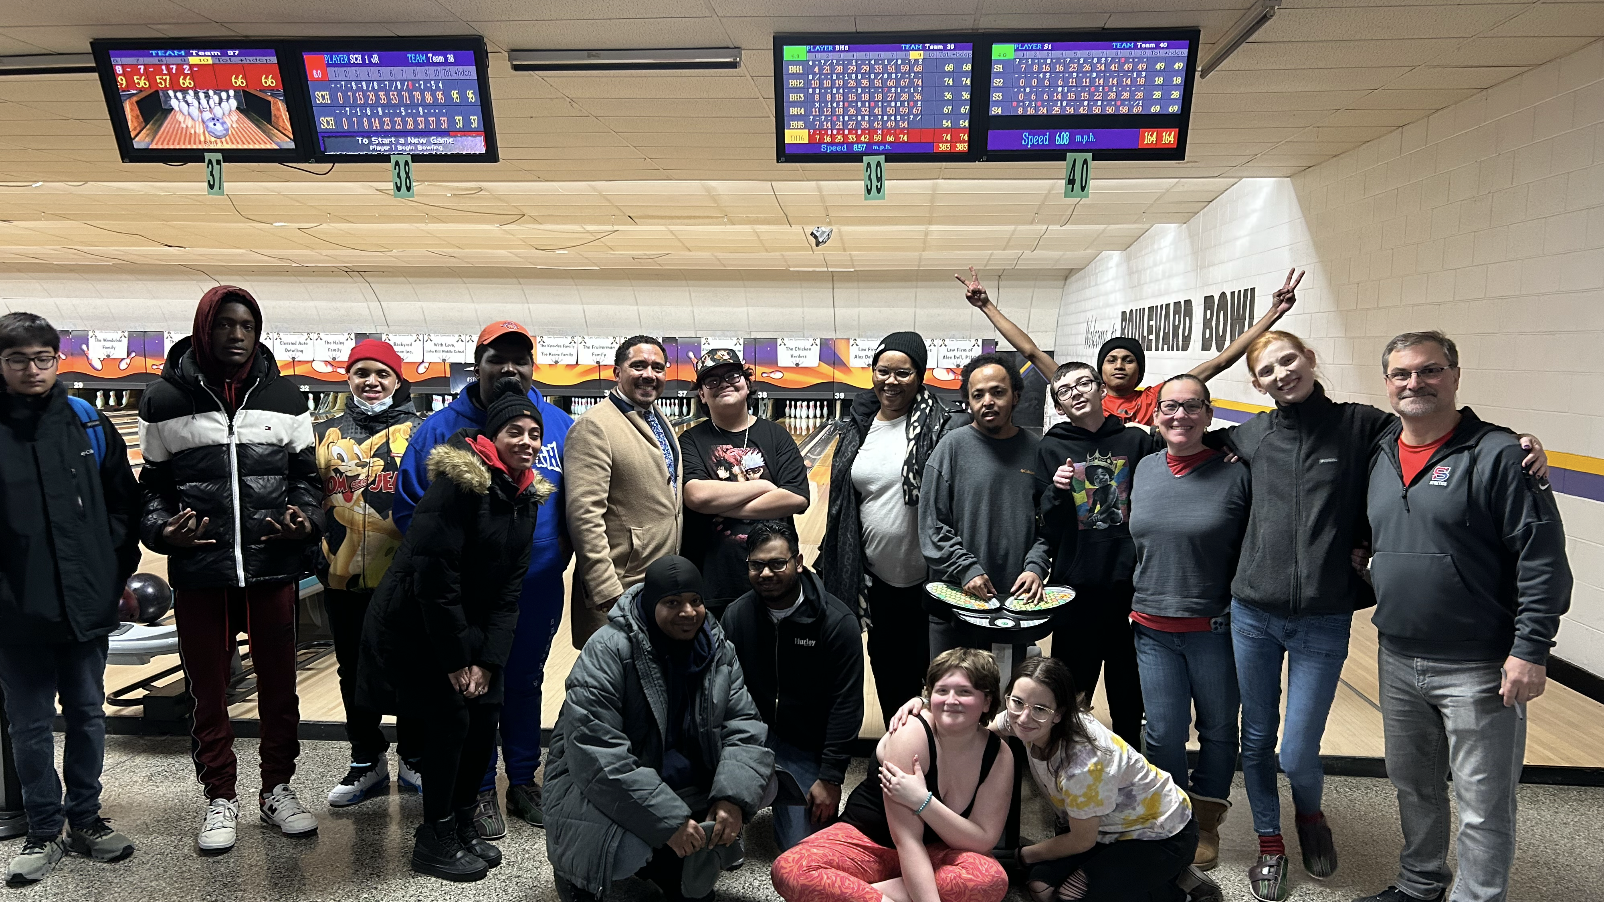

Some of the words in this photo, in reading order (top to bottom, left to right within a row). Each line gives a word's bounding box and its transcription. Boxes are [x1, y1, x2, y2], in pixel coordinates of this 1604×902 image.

[324, 54, 348, 64] PLAYER
[349, 54, 362, 64] SCH
[364, 54, 369, 64] 1
[406, 53, 427, 63] TEAM
[428, 53, 445, 63] Team
[446, 53, 455, 63] 38
[115, 65, 122, 74] 8
[137, 65, 144, 74] 7
[161, 65, 168, 74] 1
[170, 65, 177, 74] 7
[183, 65, 191, 74] 2
[788, 65, 803, 74] BH1
[944, 63, 954, 71] 68
[962, 63, 972, 71] 68
[993, 64, 1003, 72] S1
[1155, 62, 1165, 70] 49
[1173, 62, 1183, 70] 49
[133, 76, 149, 88] 56
[155, 76, 170, 88] 57
[179, 76, 194, 88] 66
[231, 74, 246, 87] 66
[261, 74, 276, 87] 66
[788, 79, 804, 88] BH2
[943, 77, 953, 86] 74
[961, 77, 971, 86] 74
[993, 78, 1003, 86] S2
[1154, 76, 1163, 85] 18
[1172, 76, 1181, 85] 18
[315, 92, 331, 104] SCH
[337, 92, 343, 104] 0
[348, 92, 353, 104] 7
[355, 92, 364, 104] 13
[367, 92, 376, 104] 29
[389, 92, 399, 104] 53
[401, 92, 410, 104] 71
[413, 92, 421, 104] 79
[424, 92, 433, 104] 86
[436, 92, 445, 104] 95
[451, 90, 460, 103] 95
[466, 90, 475, 103] 95
[789, 93, 804, 101] BH3
[943, 91, 953, 100] 36
[961, 91, 970, 100] 36
[992, 92, 1003, 100] S3
[1152, 91, 1162, 99] 28
[1170, 91, 1180, 99] 28
[789, 107, 805, 115] BH4
[943, 105, 953, 114] 67
[960, 105, 970, 114] 67
[991, 106, 1002, 114] S4
[1150, 105, 1160, 113] 69
[1168, 105, 1178, 113] 69
[320, 117, 335, 129] SCH
[342, 117, 348, 129] 0
[352, 117, 358, 129] 7
[363, 117, 369, 129] 8
[371, 117, 380, 129] 14
[405, 117, 414, 129] 28
[416, 117, 425, 129] 37
[428, 117, 436, 129] 37
[440, 117, 448, 129] 37
[454, 115, 463, 129] 37
[469, 115, 478, 129] 37
[789, 121, 805, 129] BH5
[942, 119, 951, 128] 54
[959, 119, 969, 128] 54
[407, 136, 427, 144] New
[430, 136, 455, 144] Game
[942, 133, 951, 141] 74
[959, 133, 968, 141] 74
[1021, 132, 1049, 148] Speed
[1075, 133, 1096, 143] m.p.h.
[1143, 131, 1157, 144] 164
[1161, 131, 1175, 144] 164
[820, 144, 847, 153] Speed
[938, 143, 951, 151] 383
[955, 143, 968, 151] 383
[206, 159, 222, 191] 37
[394, 159, 413, 192] 38
[865, 160, 883, 195] 39
[1067, 157, 1089, 193] 40
[1120, 299, 1193, 352] BOULEVARD
[325, 474, 348, 495] OM
[794, 637, 816, 647] Hurley
